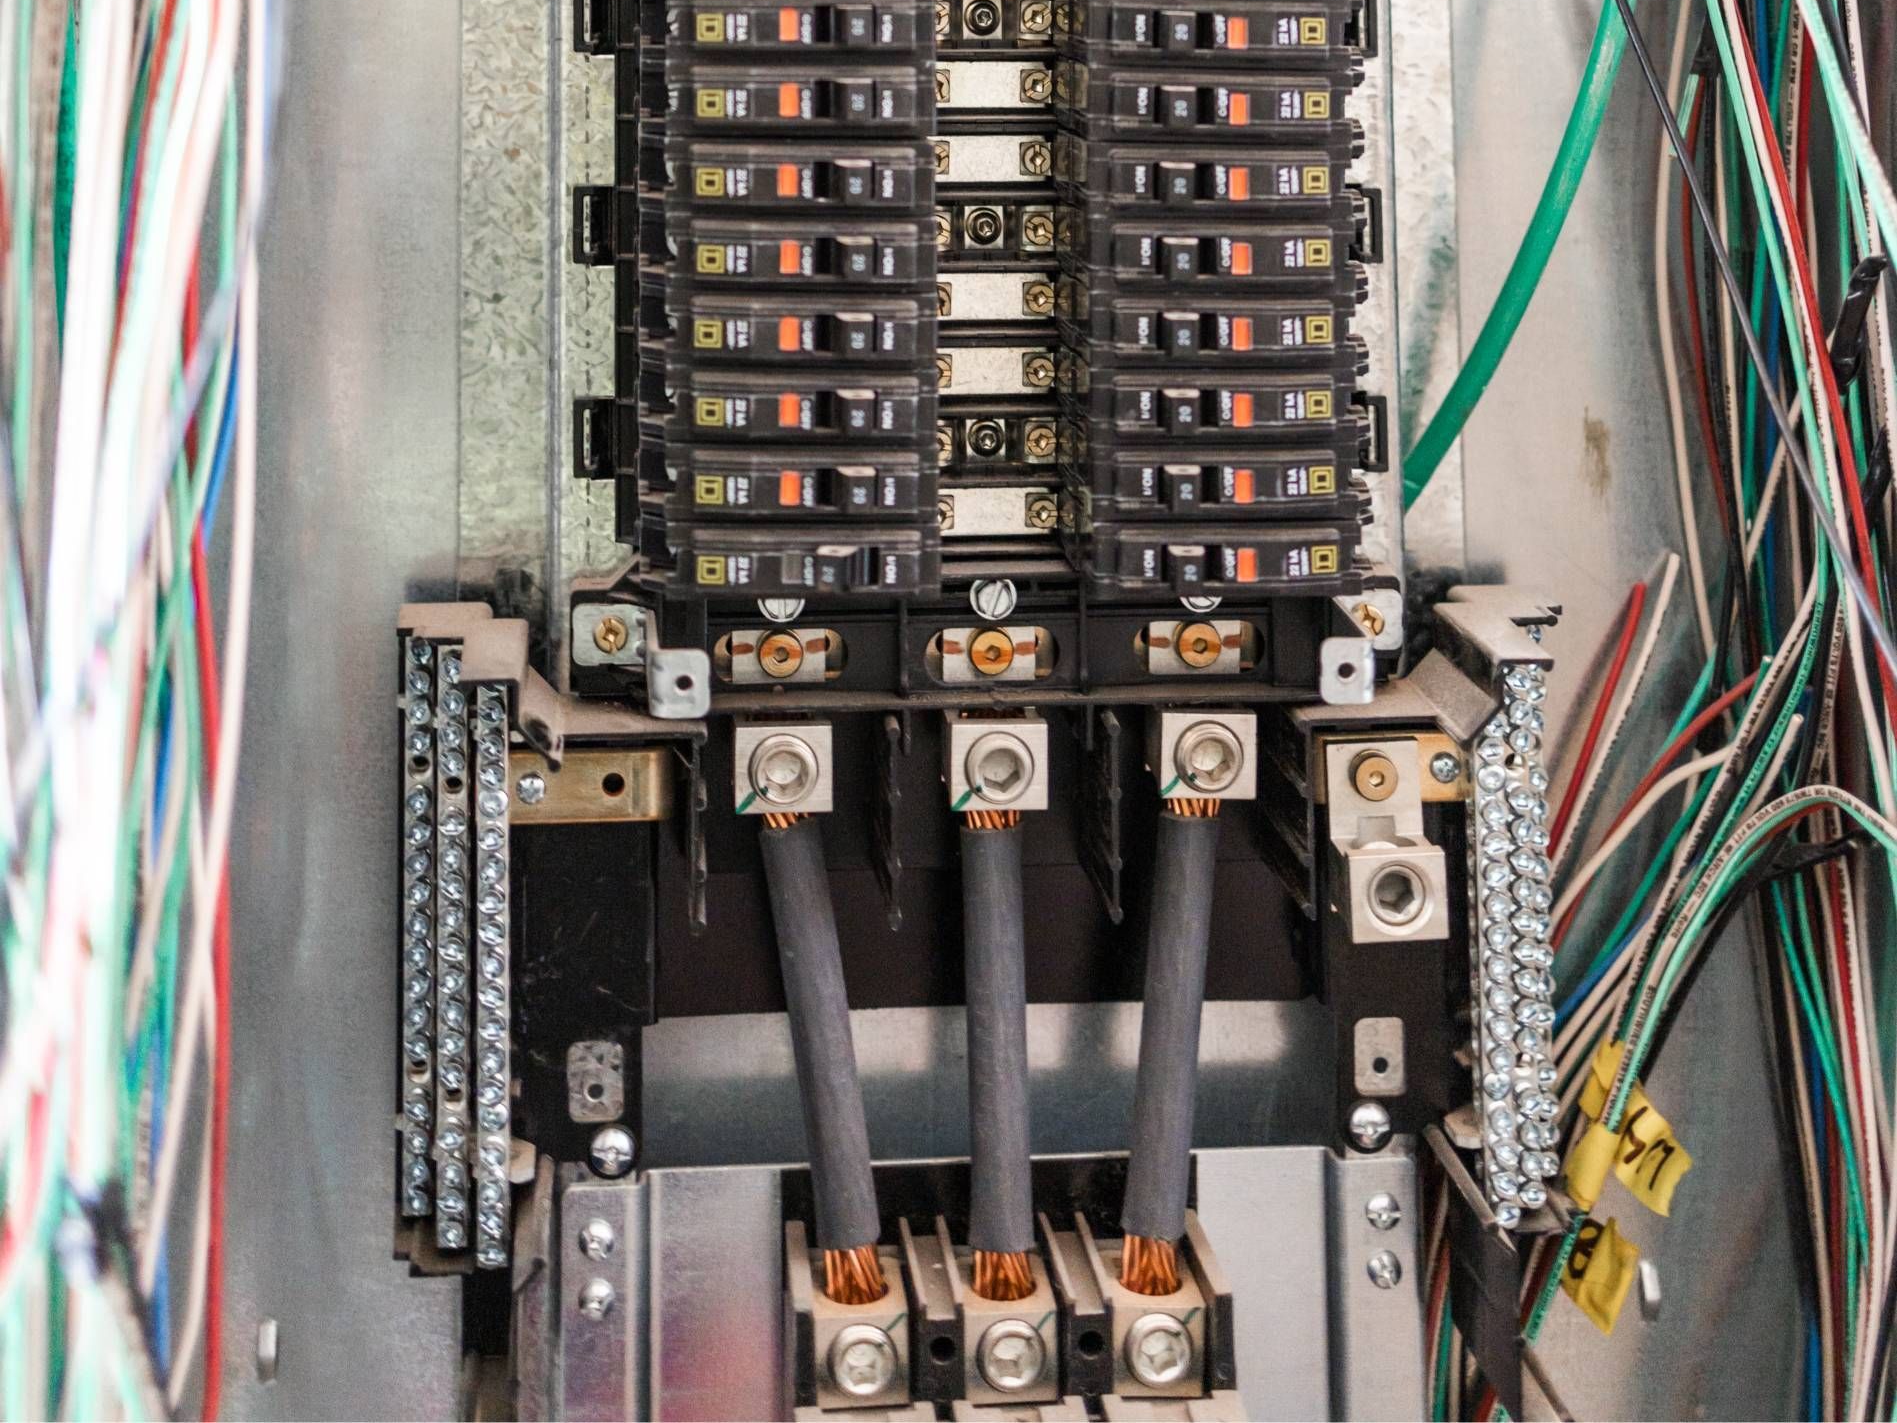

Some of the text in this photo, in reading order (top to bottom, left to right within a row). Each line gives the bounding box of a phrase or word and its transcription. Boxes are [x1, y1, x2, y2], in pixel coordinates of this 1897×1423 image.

[851, 18, 864, 36] 20
[1175, 24, 1188, 40] 20
[852, 94, 865, 111] 20
[1174, 101, 1187, 117] 20
[849, 177, 862, 194] 20
[1174, 178, 1187, 194] 20
[852, 254, 865, 271] 20
[1177, 253, 1190, 270] 20
[851, 332, 864, 349] 20
[1178, 330, 1191, 346] 20
[851, 409, 864, 427] 20
[1179, 407, 1192, 422] 20
[853, 487, 866, 504] 20
[1180, 485, 1193, 500] 20
[823, 569, 835, 584] 20
[1184, 565, 1197, 581] 20
